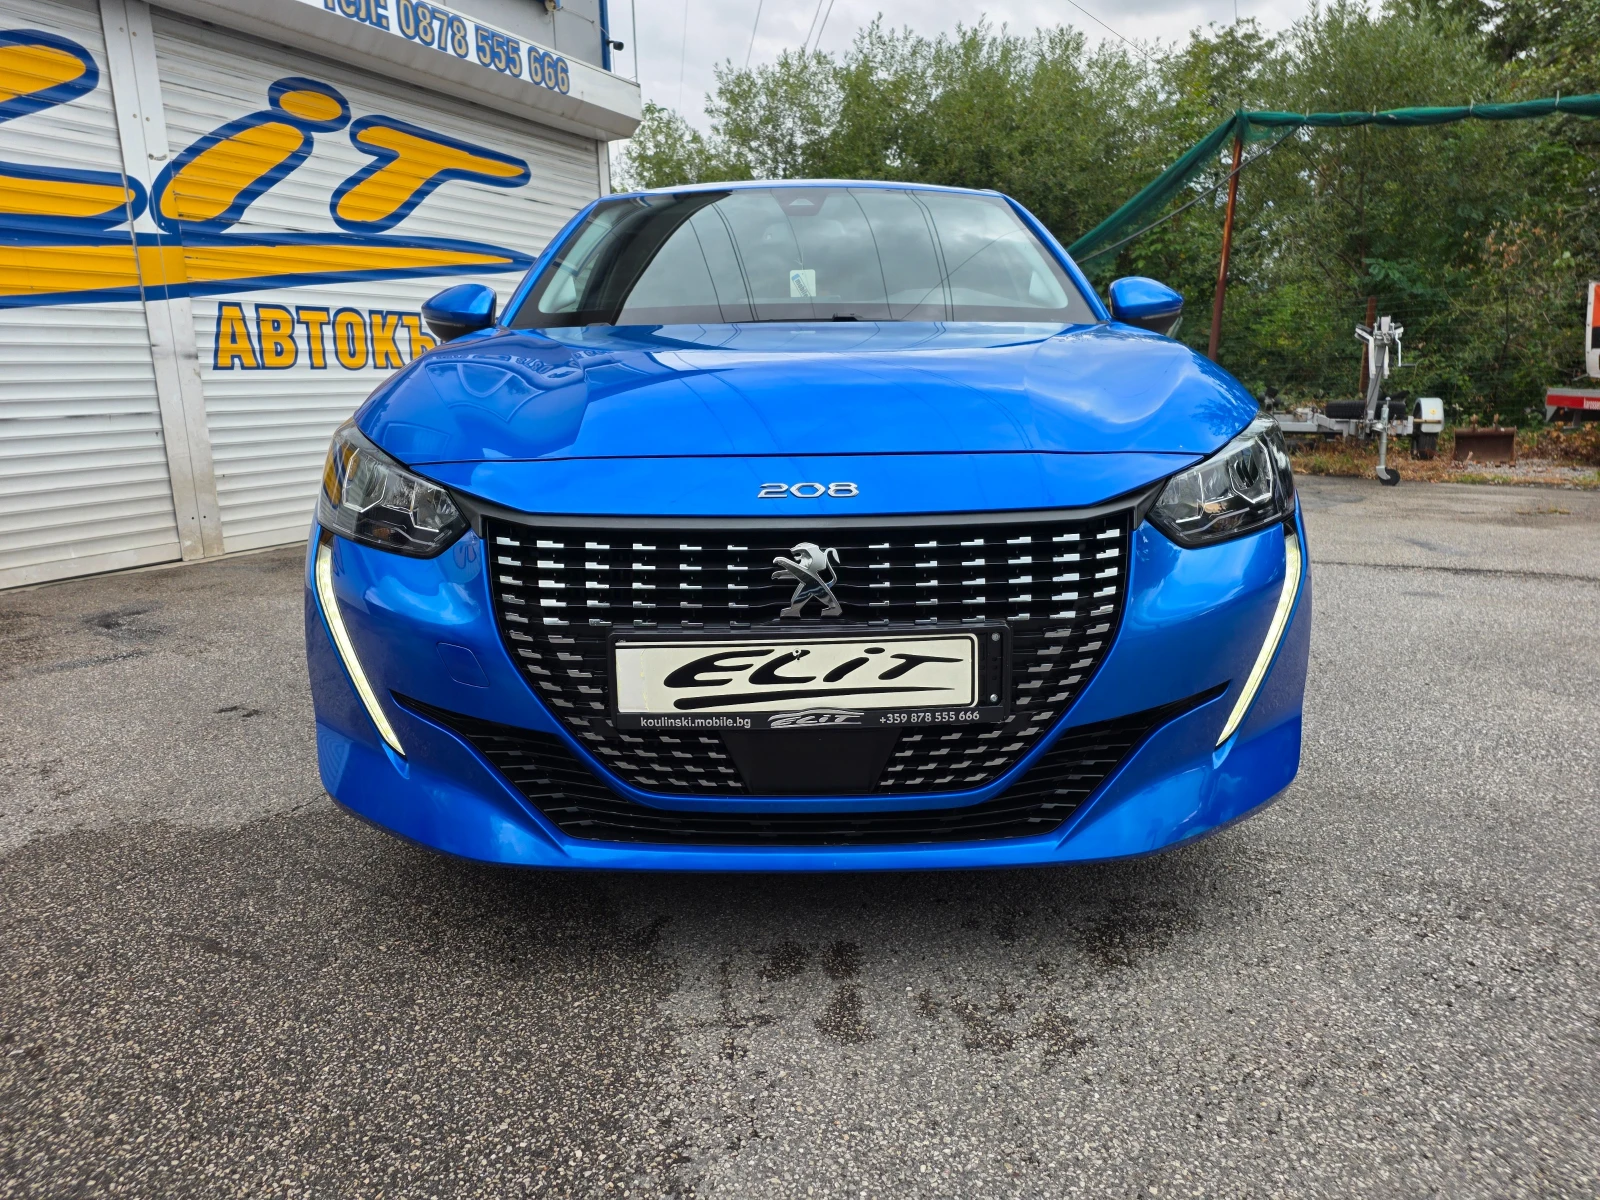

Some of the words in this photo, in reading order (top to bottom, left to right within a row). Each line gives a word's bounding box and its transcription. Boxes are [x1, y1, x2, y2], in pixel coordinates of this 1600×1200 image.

[396, 0, 469, 59] 0878
[474, 23, 523, 78] 555
[527, 45, 571, 95] 666
[212, 301, 441, 371] АВТОКЪ
[757, 482, 860, 498] 208
[640, 716, 751, 729] koulinski.mobile.bg
[879, 713, 907, 724] +359
[910, 712, 932, 723] 878
[934, 711, 956, 722] 555
[958, 710, 980, 721] 666
